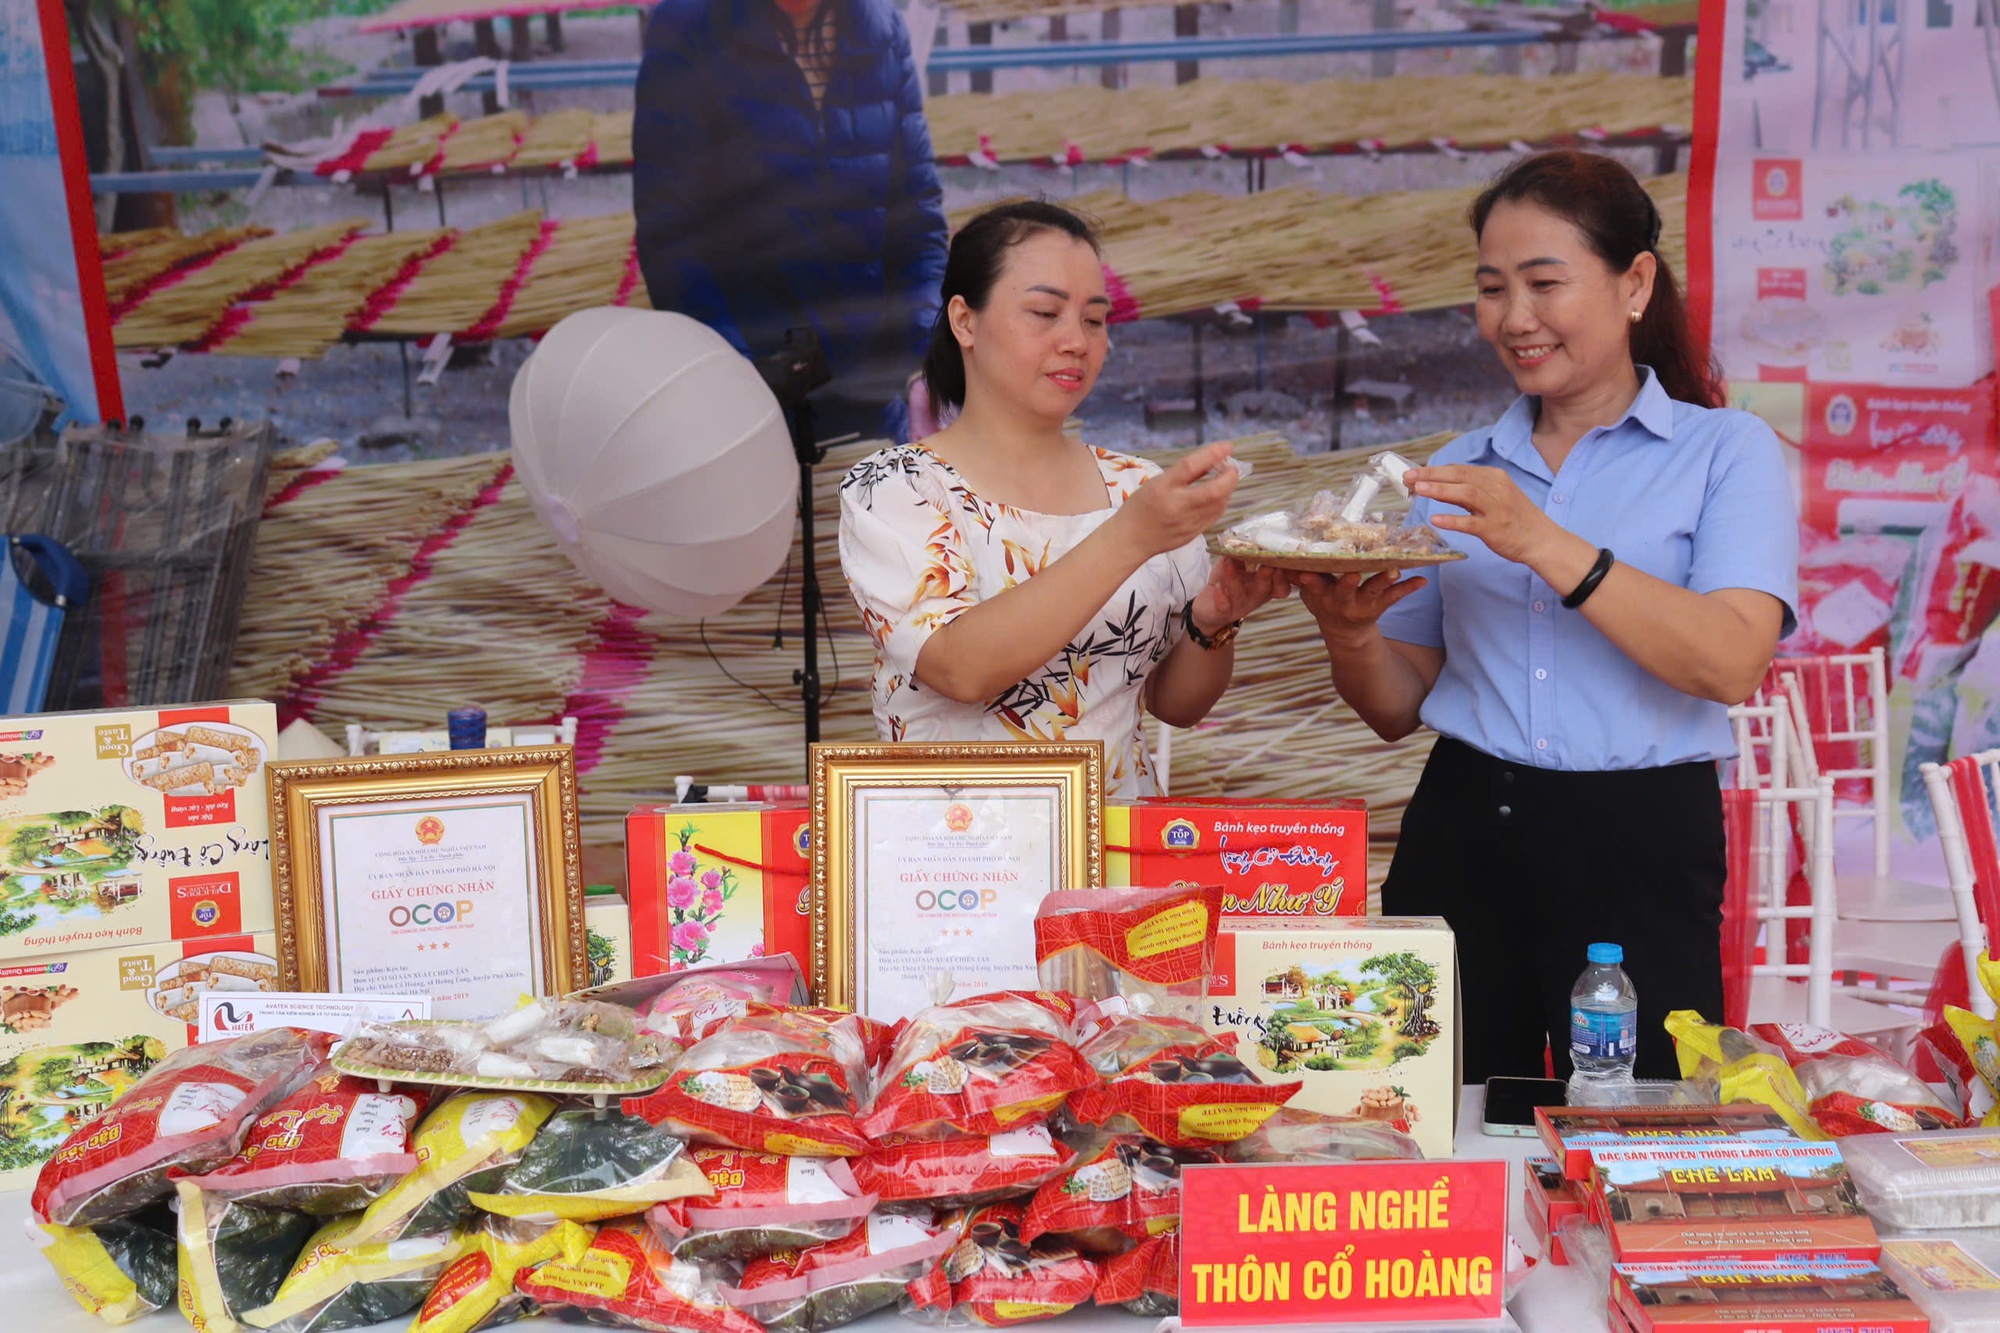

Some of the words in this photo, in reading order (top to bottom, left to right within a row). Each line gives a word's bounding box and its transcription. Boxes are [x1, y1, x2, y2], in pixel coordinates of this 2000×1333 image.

[98, 728, 128, 740] Taste
[99, 743, 129, 756] Good
[1170, 830, 1190, 840] TOP
[1213, 820, 1244, 833] Bánh
[1246, 821, 1268, 835] kẹo
[1269, 820, 1309, 836] truyền
[1310, 819, 1345, 837] thống
[899, 868, 931, 883] GIẤY
[934, 868, 979, 882] CHỨNG
[982, 867, 1019, 884] NHẬN
[371, 885, 403, 900] GIẤY
[406, 883, 453, 897] CHỨNG
[458, 878, 494, 894] NHẬN
[915, 889, 998, 911] OCOP
[389, 900, 474, 928] OCOP
[115, 926, 143, 938] Bánh
[1262, 940, 1288, 950] Bánh
[1289, 940, 1308, 952] kẹo
[1309, 940, 1341, 951] truyền
[1343, 939, 1373, 951] thống
[122, 958, 153, 972] Taste
[122, 973, 153, 987] Good
[453, 991, 469, 1001] 2019
[88, 1123, 122, 1149] Đặc
[1623, 1148, 1648, 1161] SẢN
[1650, 1146, 1697, 1161] TRUYỀN
[1698, 1145, 1739, 1160] THỐNG
[1741, 1144, 1772, 1159] LÀNG
[1774, 1144, 1790, 1158] CỔ
[709, 1169, 744, 1189] Đặc
[1671, 1164, 1721, 1184] CHÈ
[1725, 1166, 1778, 1183] LAM
[1238, 1183, 1338, 1234] LÀNG
[1349, 1175, 1451, 1231] NGHỀ
[1191, 1253, 1291, 1304] THÔN
[1303, 1243, 1356, 1301] CỔ
[1365, 1249, 1493, 1299] HOÀNG
[1700, 1272, 1752, 1284] CHÈ
[1758, 1273, 1811, 1284] LAM
